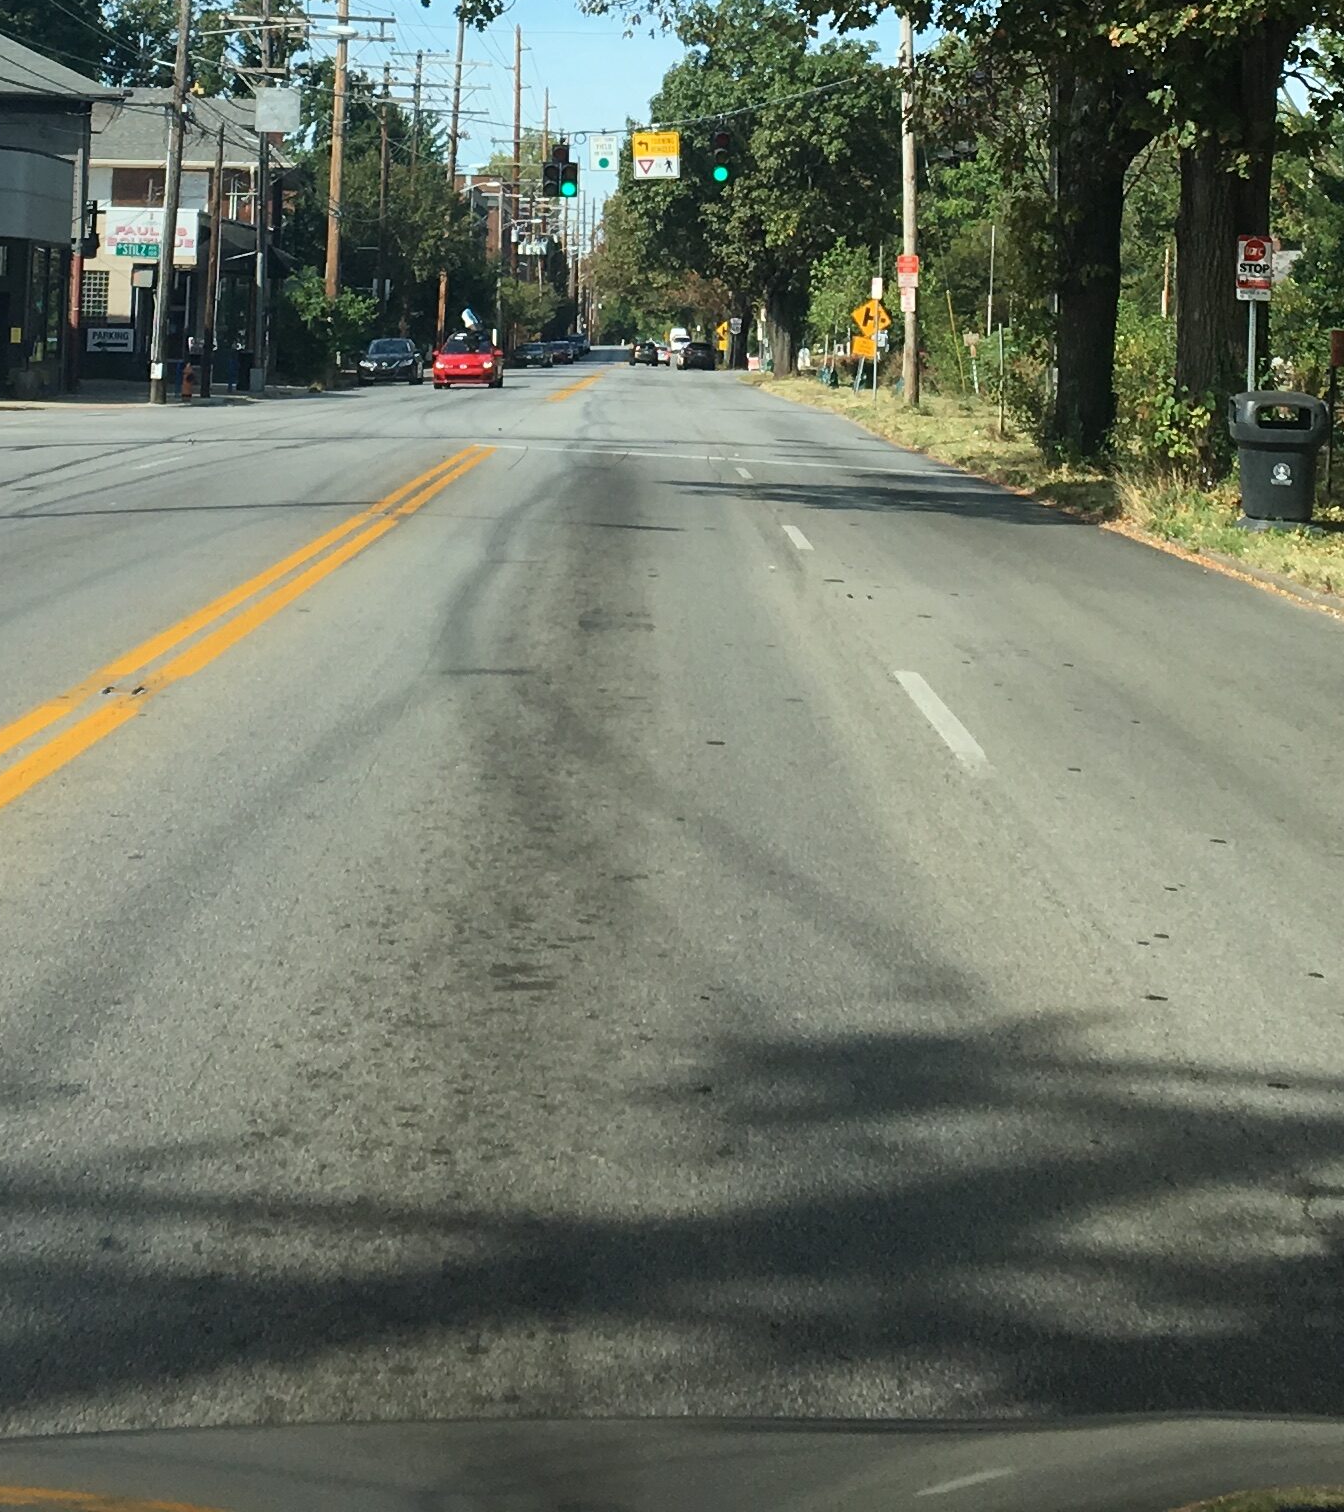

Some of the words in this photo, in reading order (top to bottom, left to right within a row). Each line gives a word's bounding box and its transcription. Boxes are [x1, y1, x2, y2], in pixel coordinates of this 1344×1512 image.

[122, 244, 146, 256] STILZ
[1239, 262, 1271, 274] STOP
[92, 331, 129, 340] PARKING
